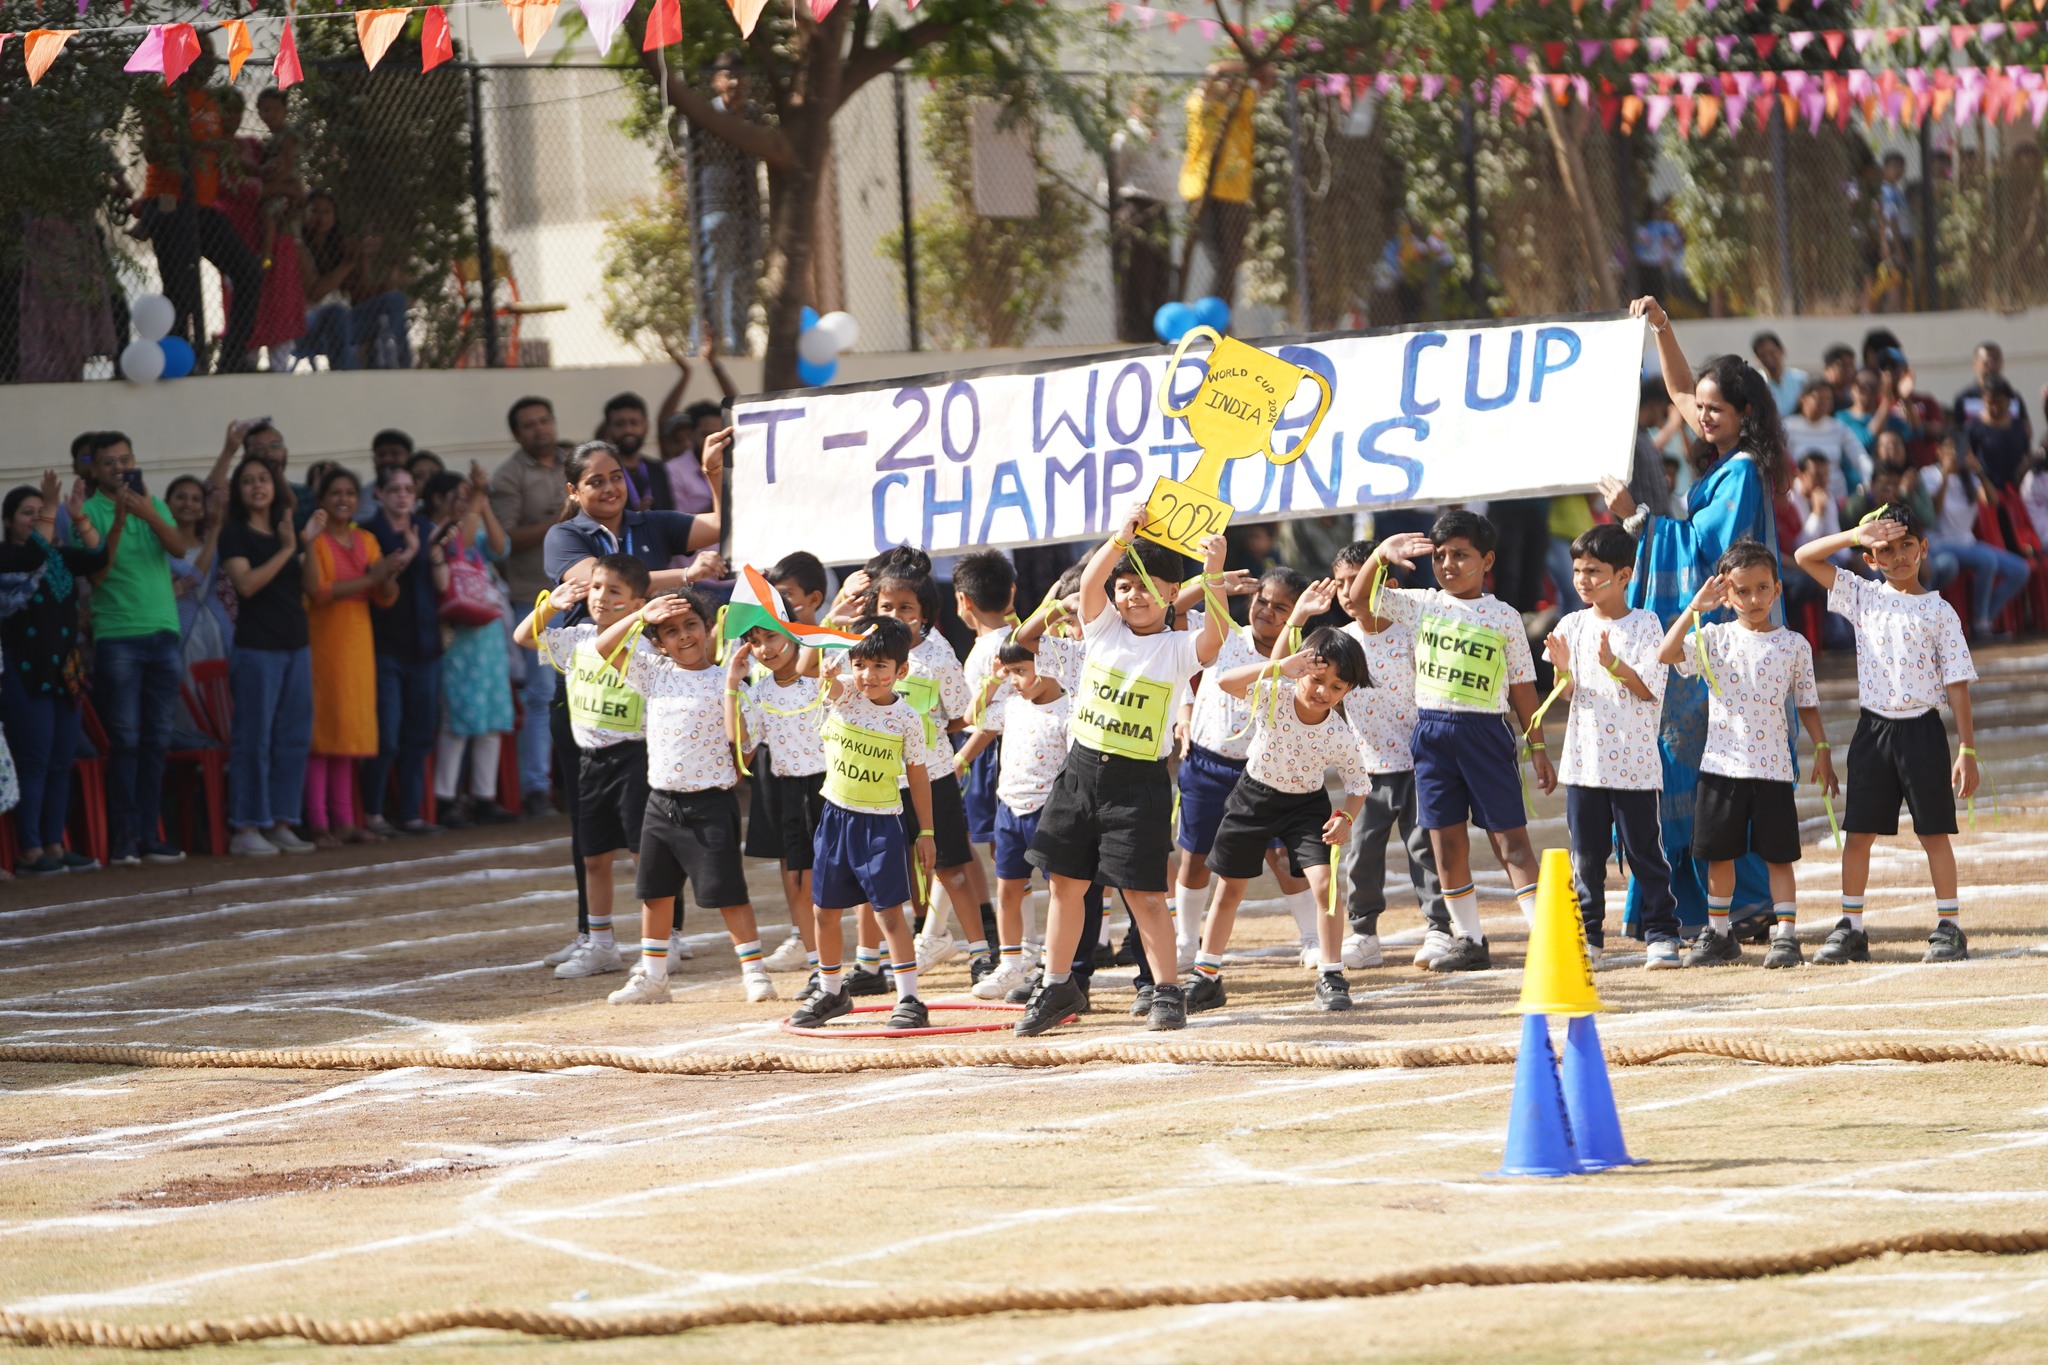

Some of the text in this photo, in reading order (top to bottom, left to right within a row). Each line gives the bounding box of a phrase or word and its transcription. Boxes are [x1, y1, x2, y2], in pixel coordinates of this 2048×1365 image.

[1032, 344, 1338, 453] WORD
[1400, 326, 1582, 417] CUP
[1207, 368, 1277, 423] WORLD CUP 2024
[1204, 388, 1262, 426] INDIA
[1420, 629, 1497, 662] WICKET
[1418, 659, 1490, 692] KEEPER
[573, 693, 628, 719] MILLER
[1092, 680, 1150, 710] ROHIT
[1077, 706, 1154, 742] SHARMA
[833, 754, 885, 783] YADAV
